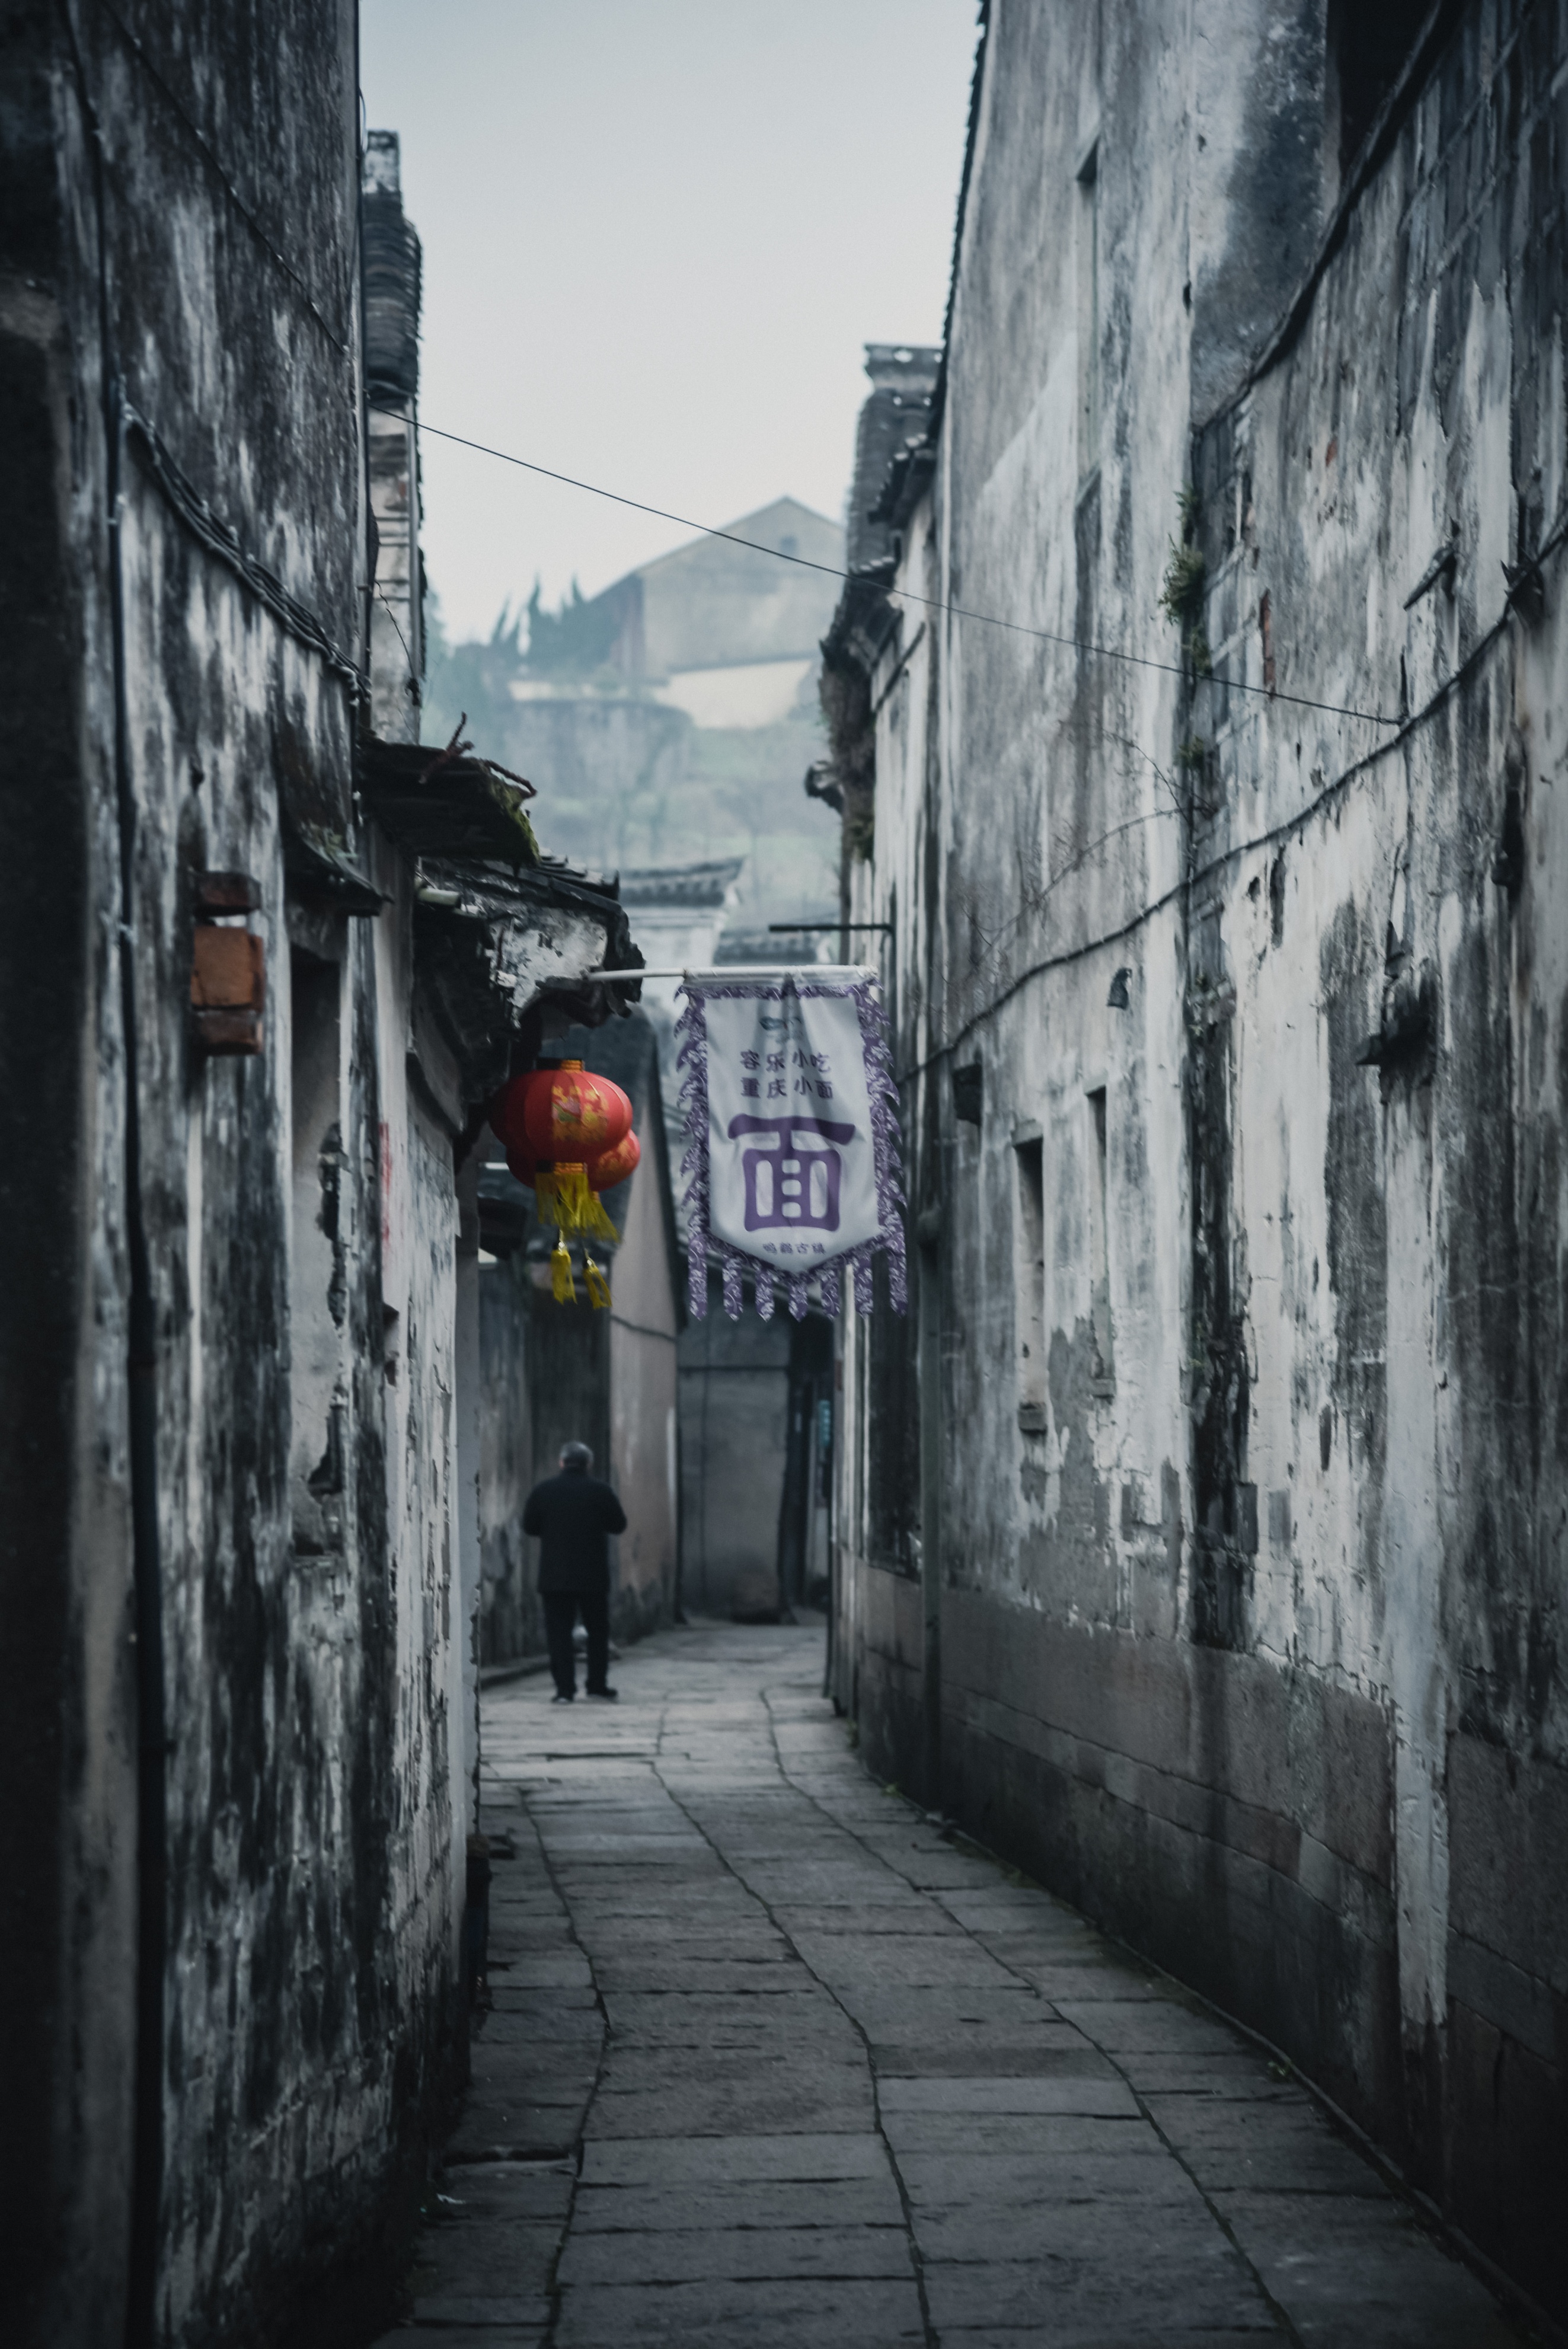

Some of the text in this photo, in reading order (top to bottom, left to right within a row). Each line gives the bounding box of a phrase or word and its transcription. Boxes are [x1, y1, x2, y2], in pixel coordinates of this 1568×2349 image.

[740, 1075, 834, 1099] 重庆小面
[728, 1113, 855, 1232] 面
